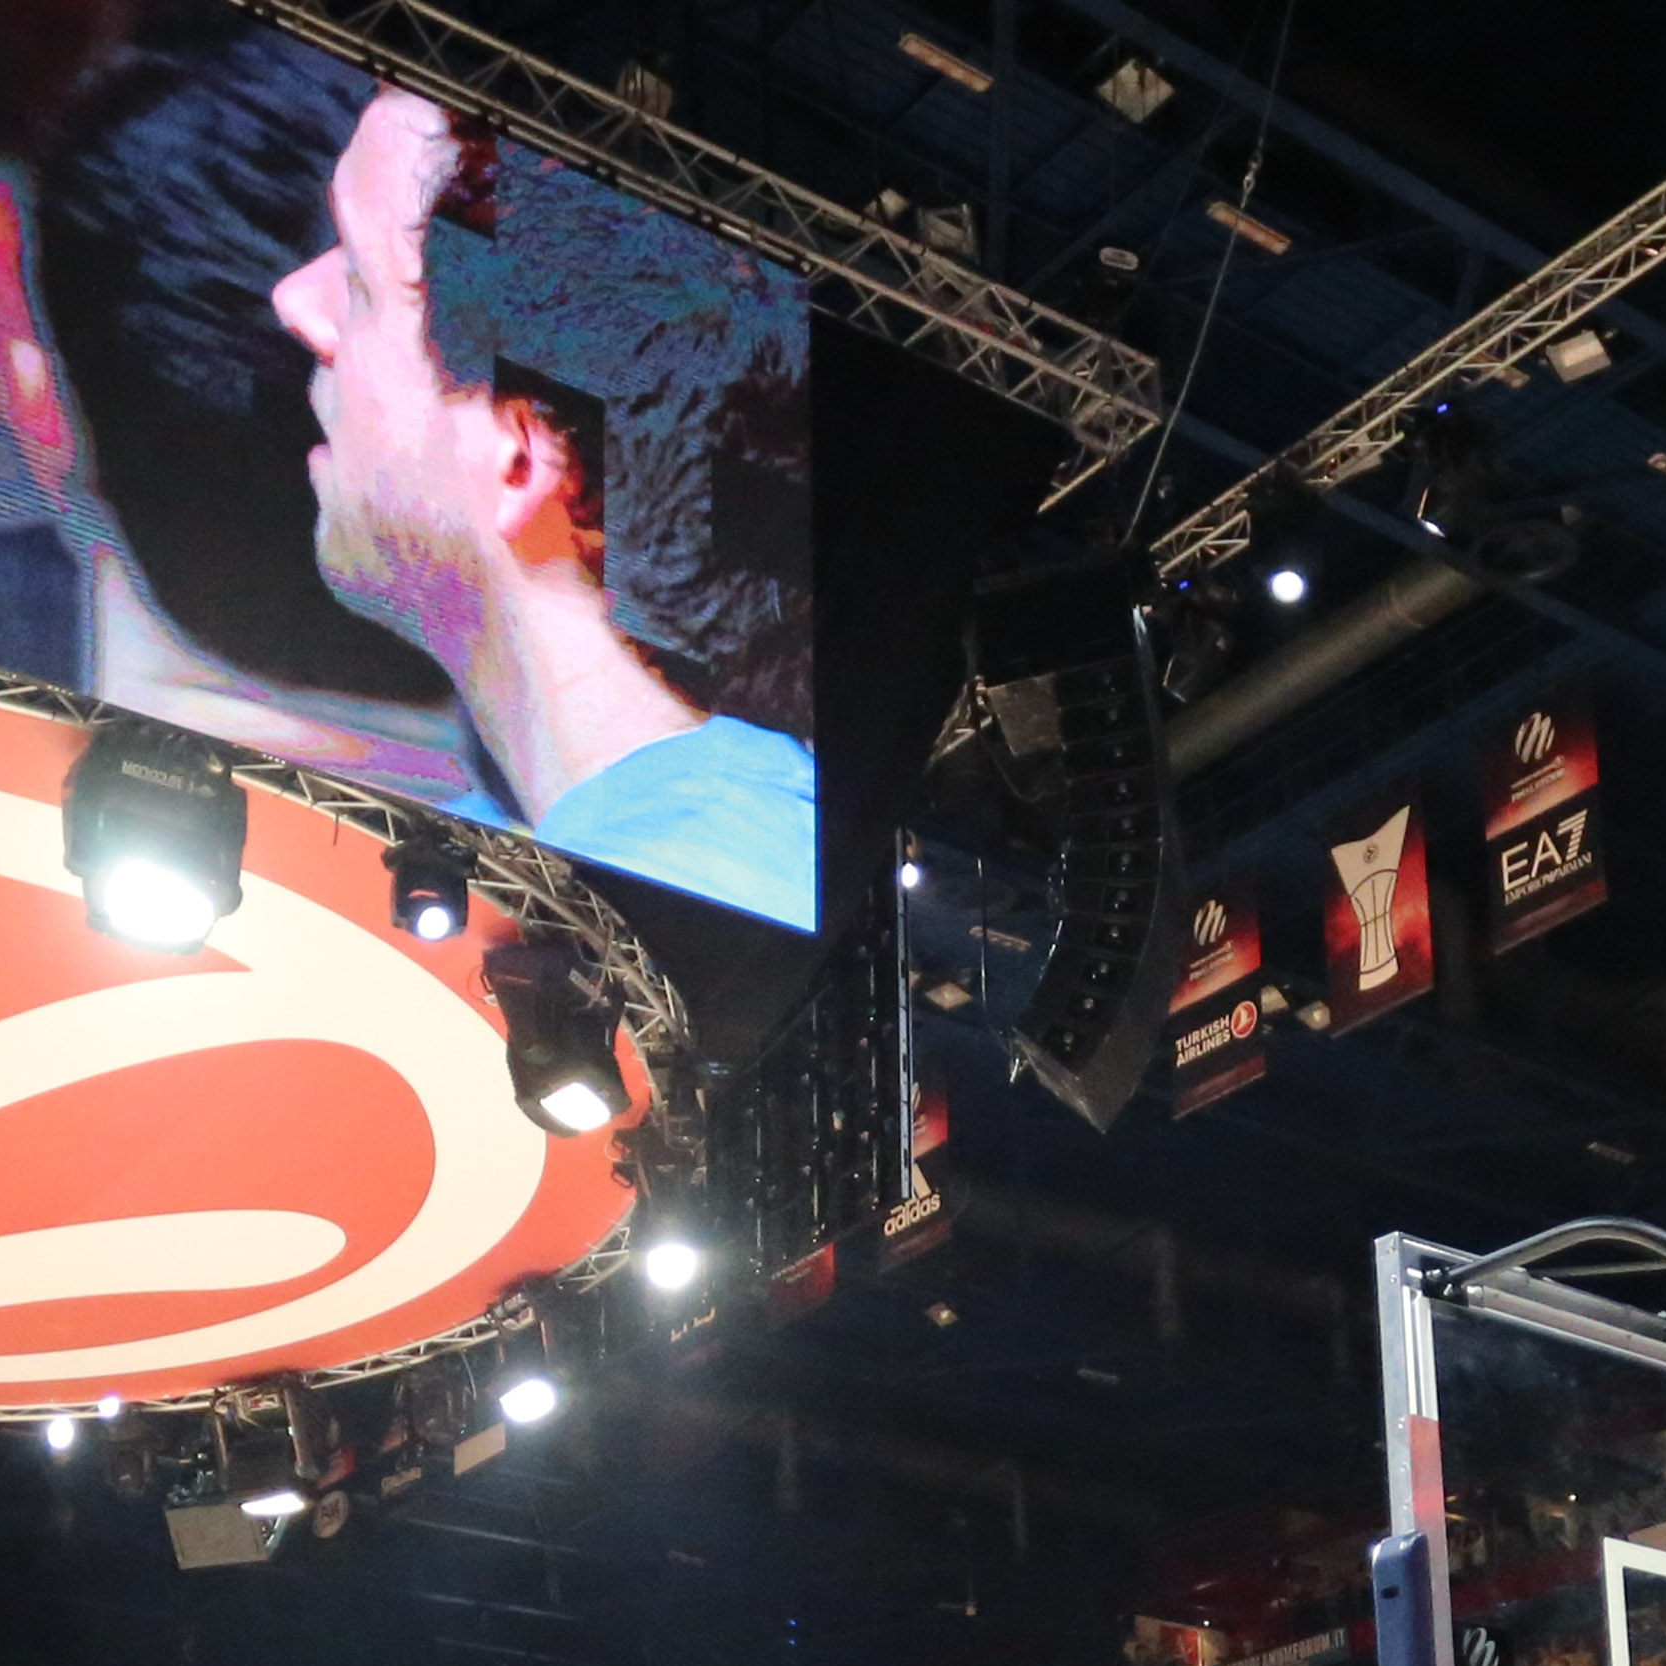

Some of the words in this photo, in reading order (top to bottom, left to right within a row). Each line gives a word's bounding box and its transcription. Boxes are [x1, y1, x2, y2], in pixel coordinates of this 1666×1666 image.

[1501, 809, 1589, 892] EA7
[1175, 1014, 1230, 1054] TURKISH
[1176, 1031, 1231, 1068] AIRLINES
[884, 1193, 941, 1236] adidas
